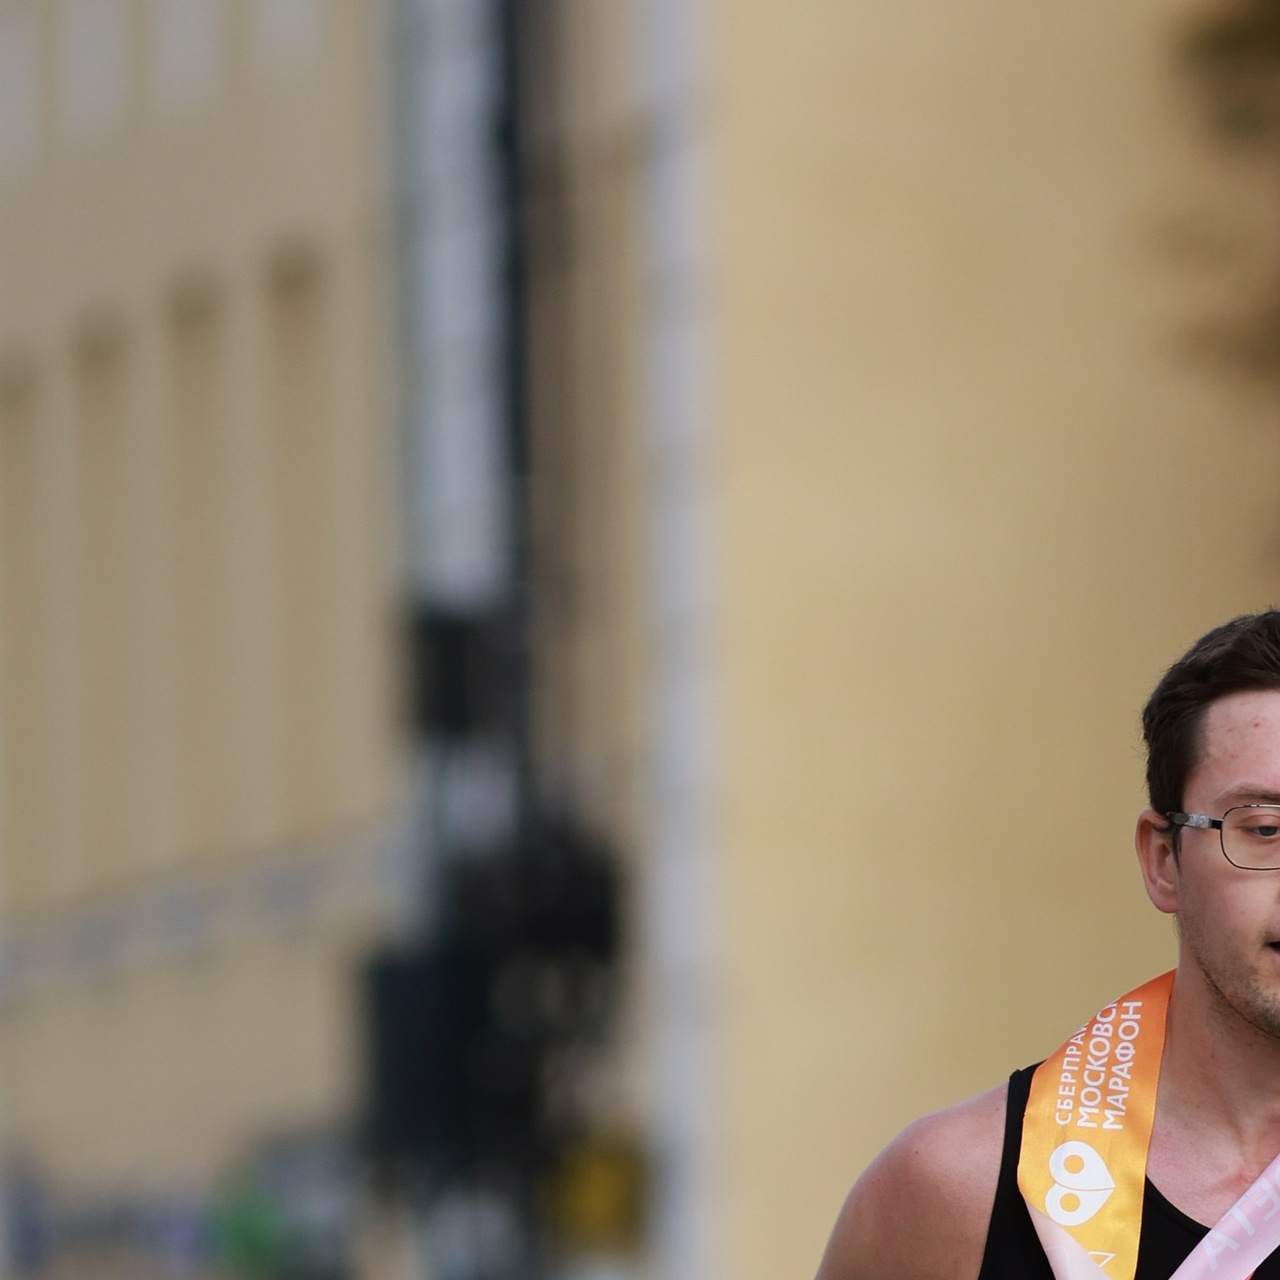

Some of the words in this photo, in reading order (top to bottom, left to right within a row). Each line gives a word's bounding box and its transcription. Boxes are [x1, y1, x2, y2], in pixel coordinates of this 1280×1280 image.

[1055, 1022, 1089, 1126] СБЕРПРА
[1077, 1001, 1118, 1128] МОСКОВС
[1102, 1001, 1143, 1130] МАРАФОН
